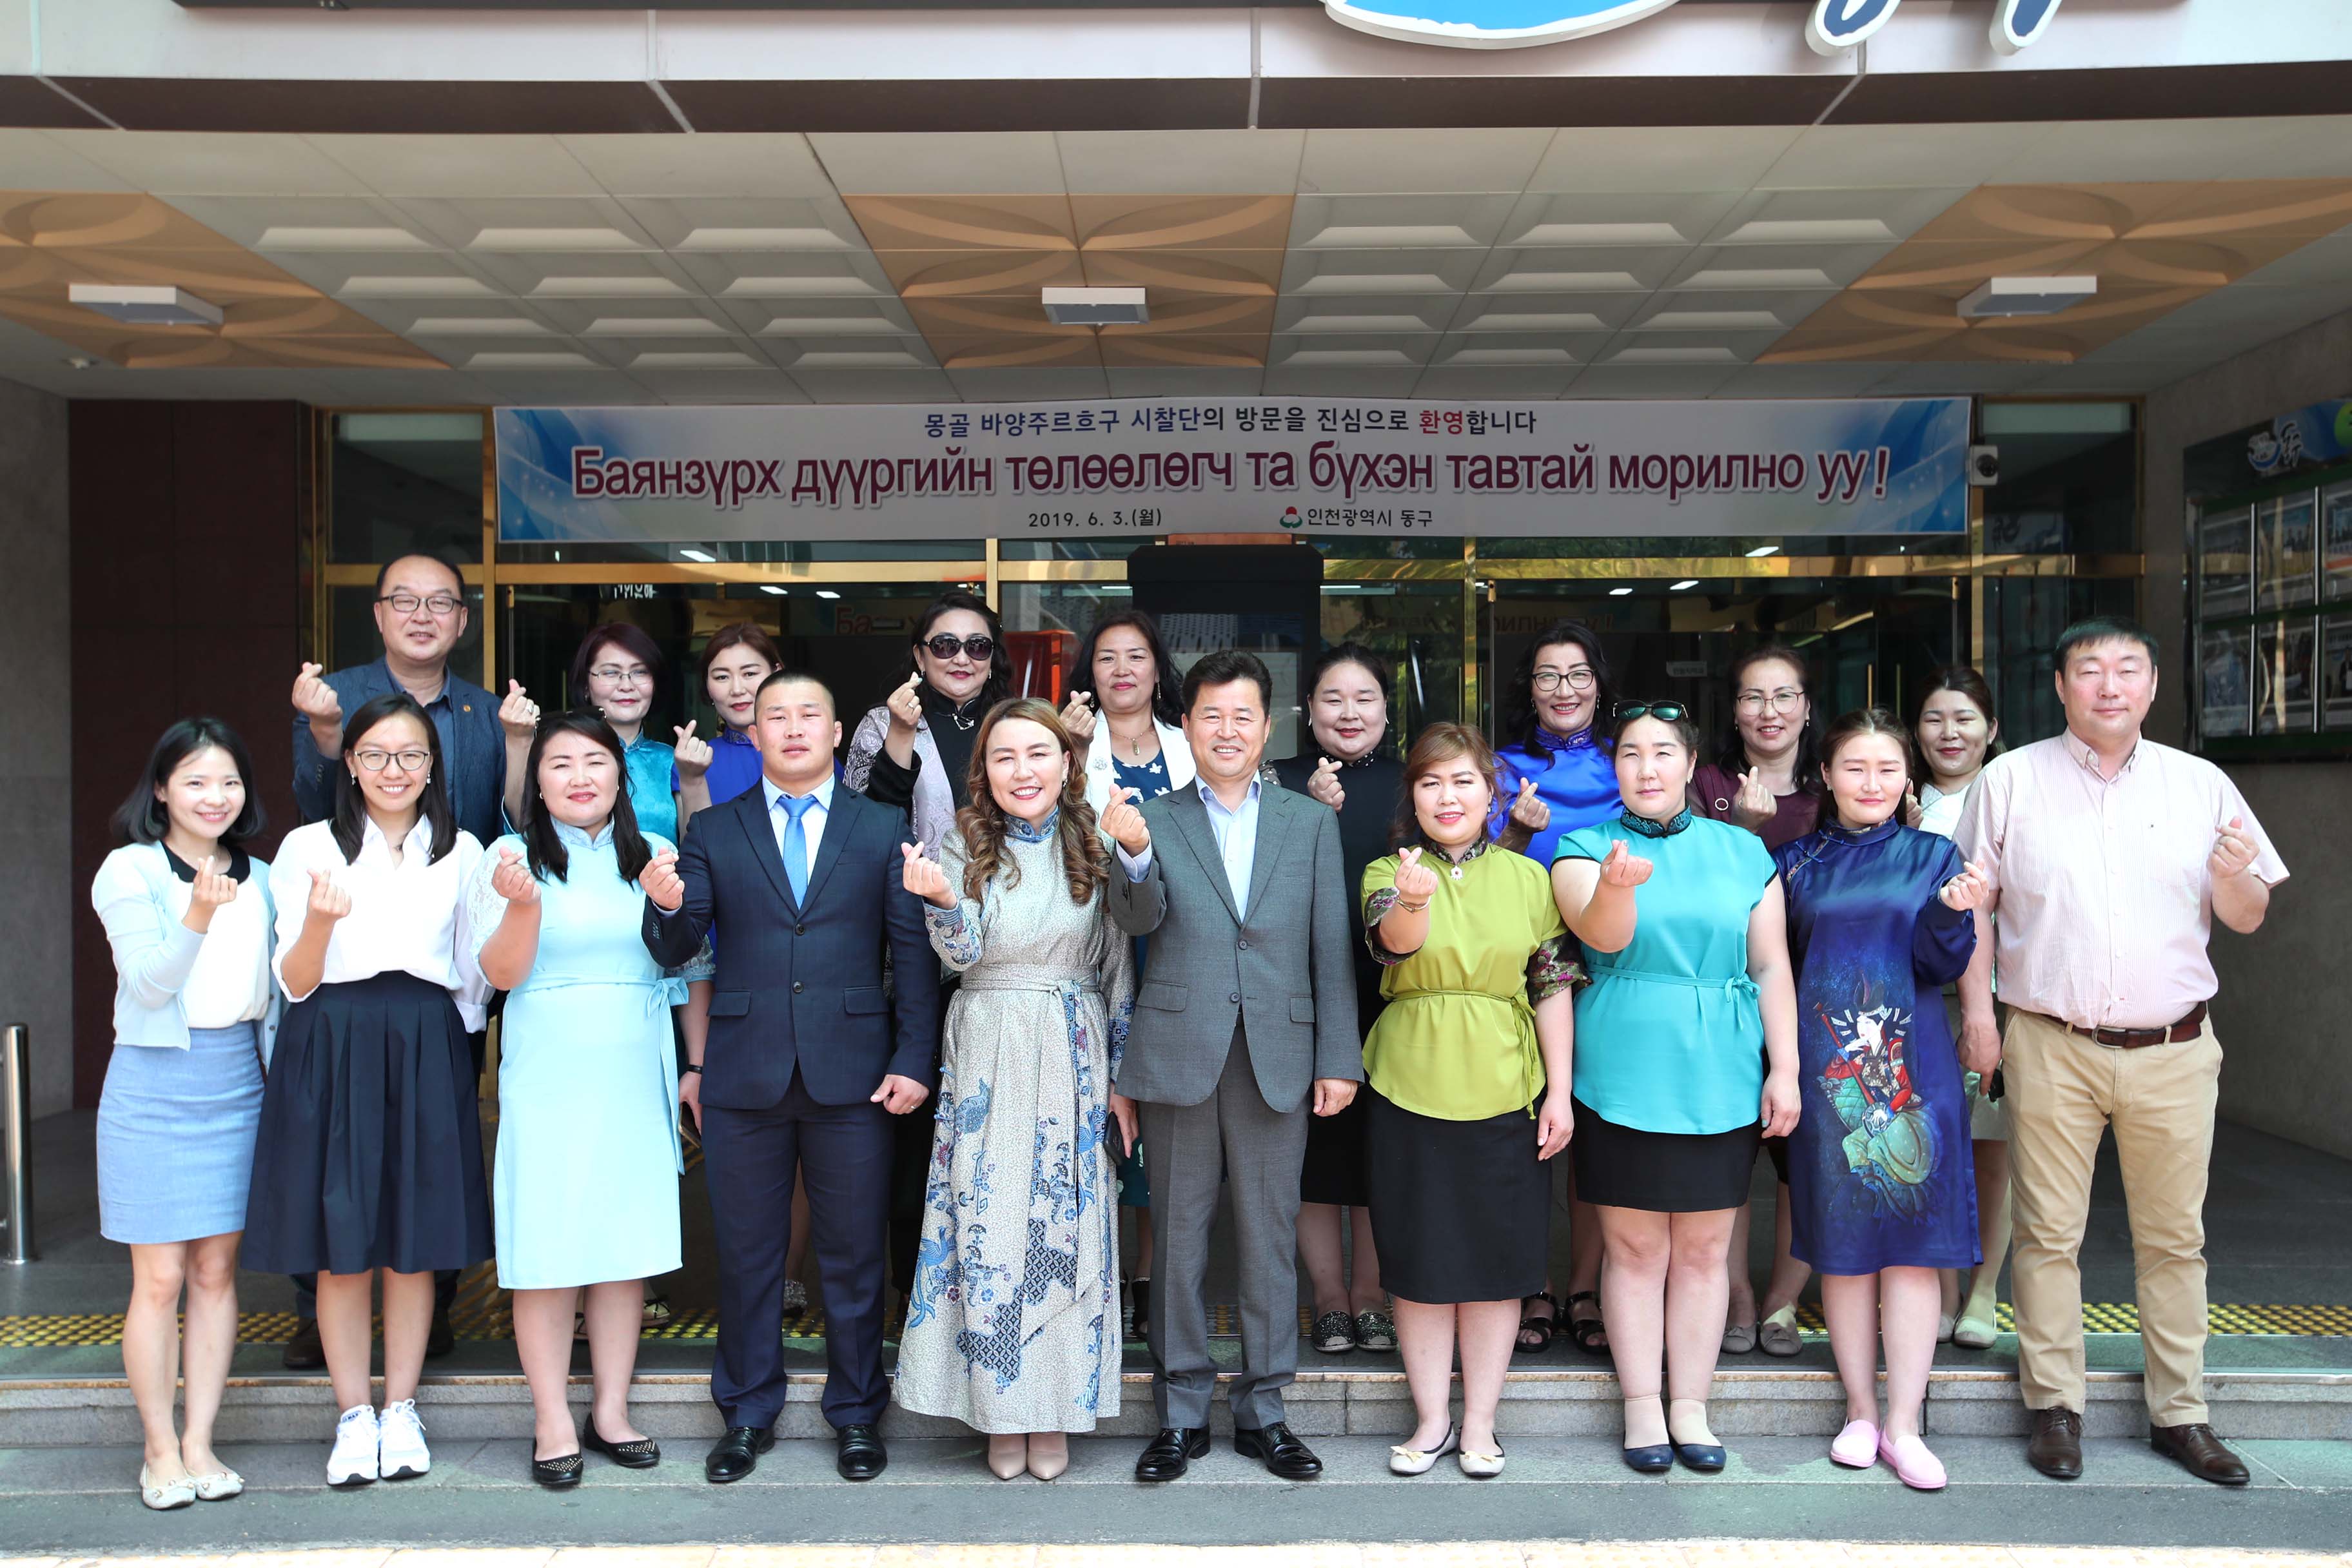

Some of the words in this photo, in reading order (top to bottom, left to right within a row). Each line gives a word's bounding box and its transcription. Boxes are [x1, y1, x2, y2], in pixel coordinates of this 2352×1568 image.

[925, 413, 970, 438] 몽골
[981, 410, 1120, 436] 바양주르흐구
[1131, 407, 1224, 433] 시찰단의
[1236, 407, 1306, 432] 방문을
[1317, 407, 1409, 433] 진심으로
[1419, 409, 1537, 435] 환영합니다
[575, 449, 780, 505] Баянзүрх
[792, 446, 992, 505] дүүргийн
[1006, 452, 1232, 491] төлөөлөгч
[1247, 451, 1295, 487] та
[1309, 440, 1433, 499] бүхэн
[1447, 444, 1594, 489] тавтай
[1609, 453, 1805, 500] морилно
[1028, 512, 1079, 527] 2019.
[1088, 512, 1103, 526] 6.
[1308, 508, 1391, 527] 인천광역시
[1400, 510, 1433, 527] 동구
